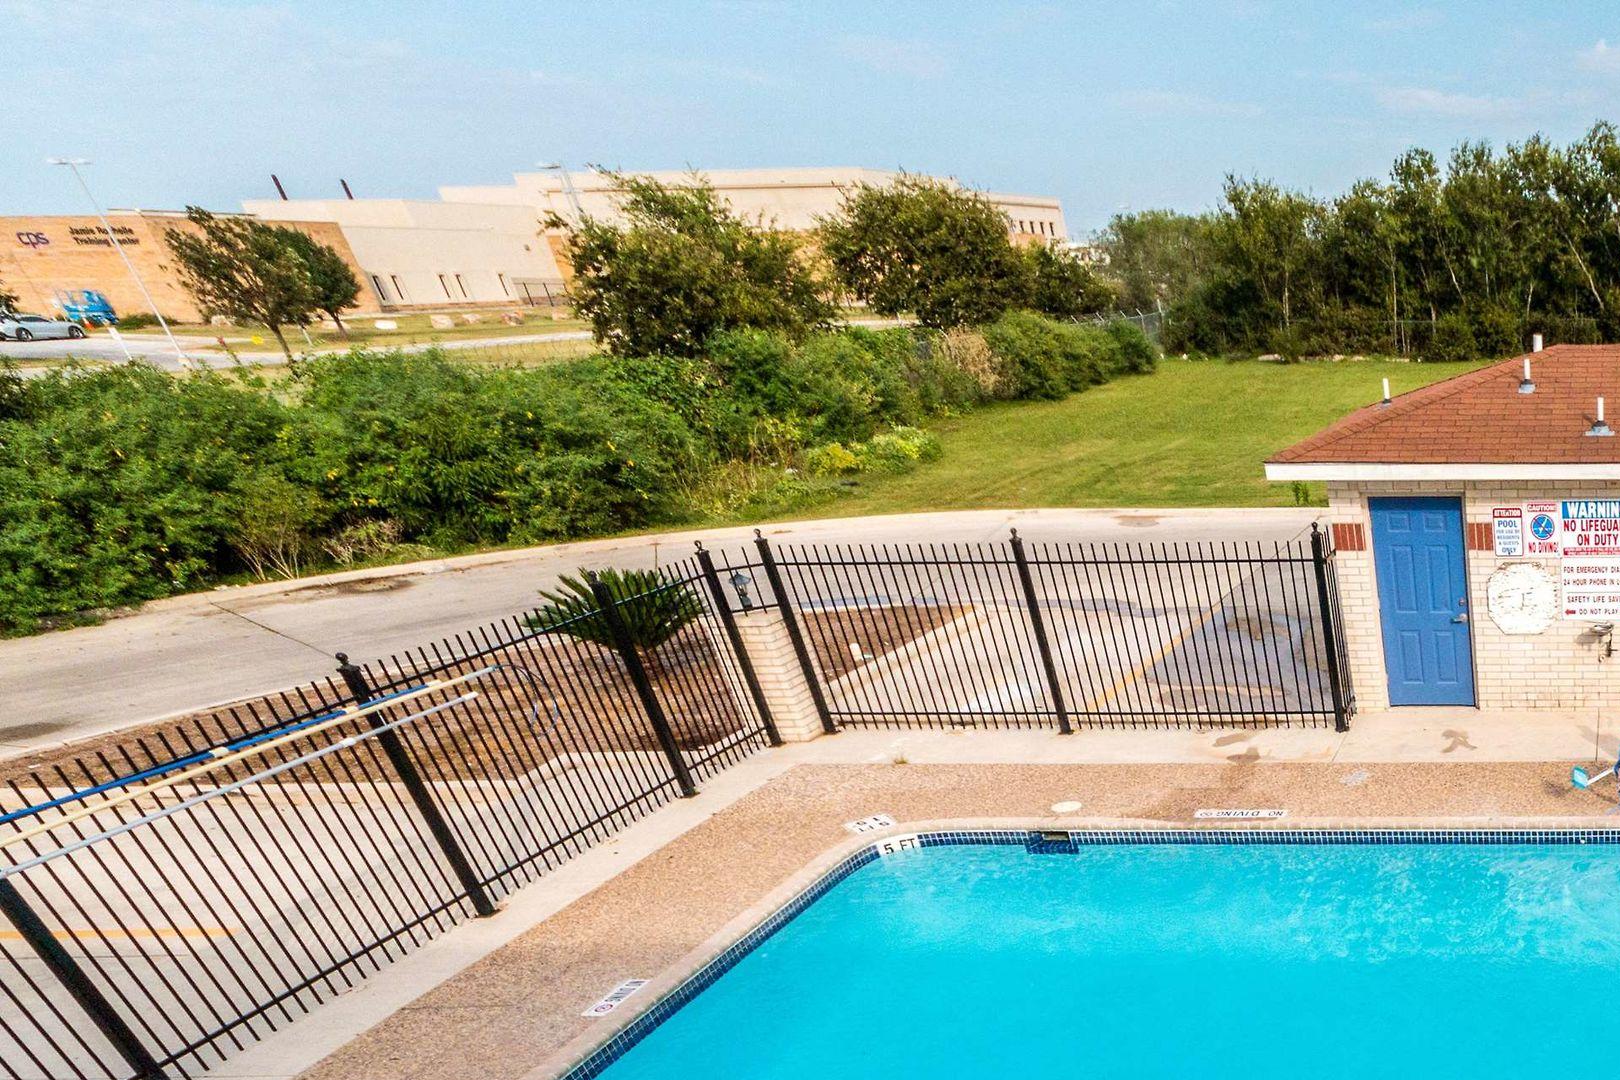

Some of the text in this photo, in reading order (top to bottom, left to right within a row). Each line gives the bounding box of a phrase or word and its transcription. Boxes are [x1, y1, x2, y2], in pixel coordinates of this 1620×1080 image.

[95, 226, 135, 235] Rohelle
[16, 232, 50, 249] cps
[1498, 520, 1518, 528] POOL
[1563, 520, 1577, 532] NO
[1577, 534, 1619, 546] ON DUTY
[1528, 542, 1537, 553] NO
[1576, 566, 1608, 574] EMERGENCY
[1563, 578, 1570, 586] 24
[1572, 578, 1587, 586] HOUR
[1589, 578, 1607, 586] PHONE
[1567, 595, 1590, 603] SAFETY
[1593, 595, 1605, 603] LIFE
[883, 838, 916, 855] 5 FT
